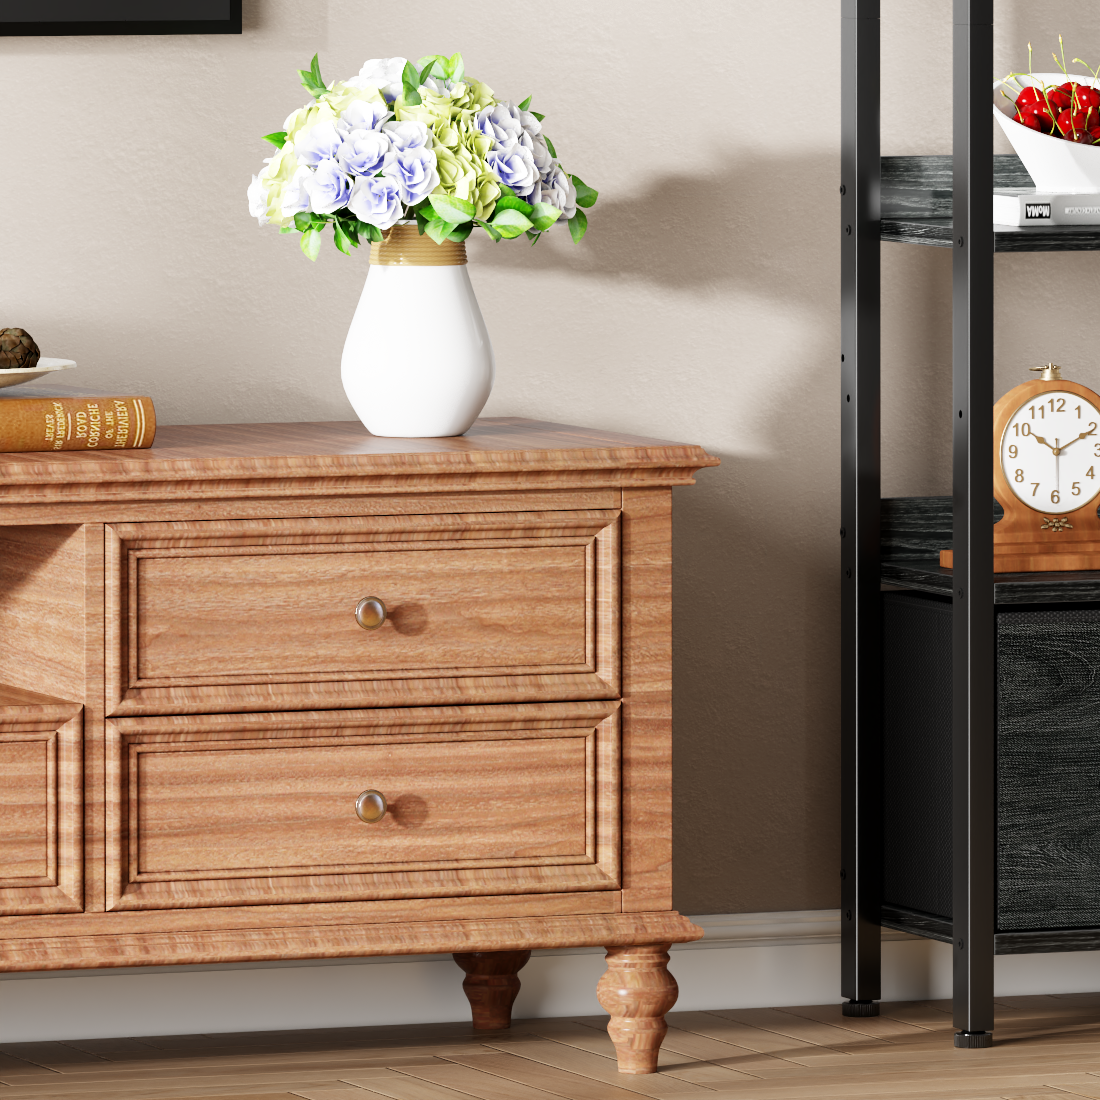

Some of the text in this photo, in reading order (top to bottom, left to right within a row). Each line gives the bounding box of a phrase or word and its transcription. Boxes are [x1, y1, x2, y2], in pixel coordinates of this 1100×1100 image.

[1026, 204, 1050, 219] MoMA
[1028, 405, 1046, 419] 11
[1047, 398, 1067, 413] 12
[1074, 405, 1082, 419] 1
[1012, 422, 1031, 437] 10
[1087, 422, 1098, 436] 2
[1008, 444, 1018, 459] 9
[1014, 468, 1024, 483] 8
[1085, 465, 1096, 480] 4
[1030, 482, 1040, 497] 7
[1071, 481, 1081, 496] 5
[1050, 489, 1060, 504] 6
